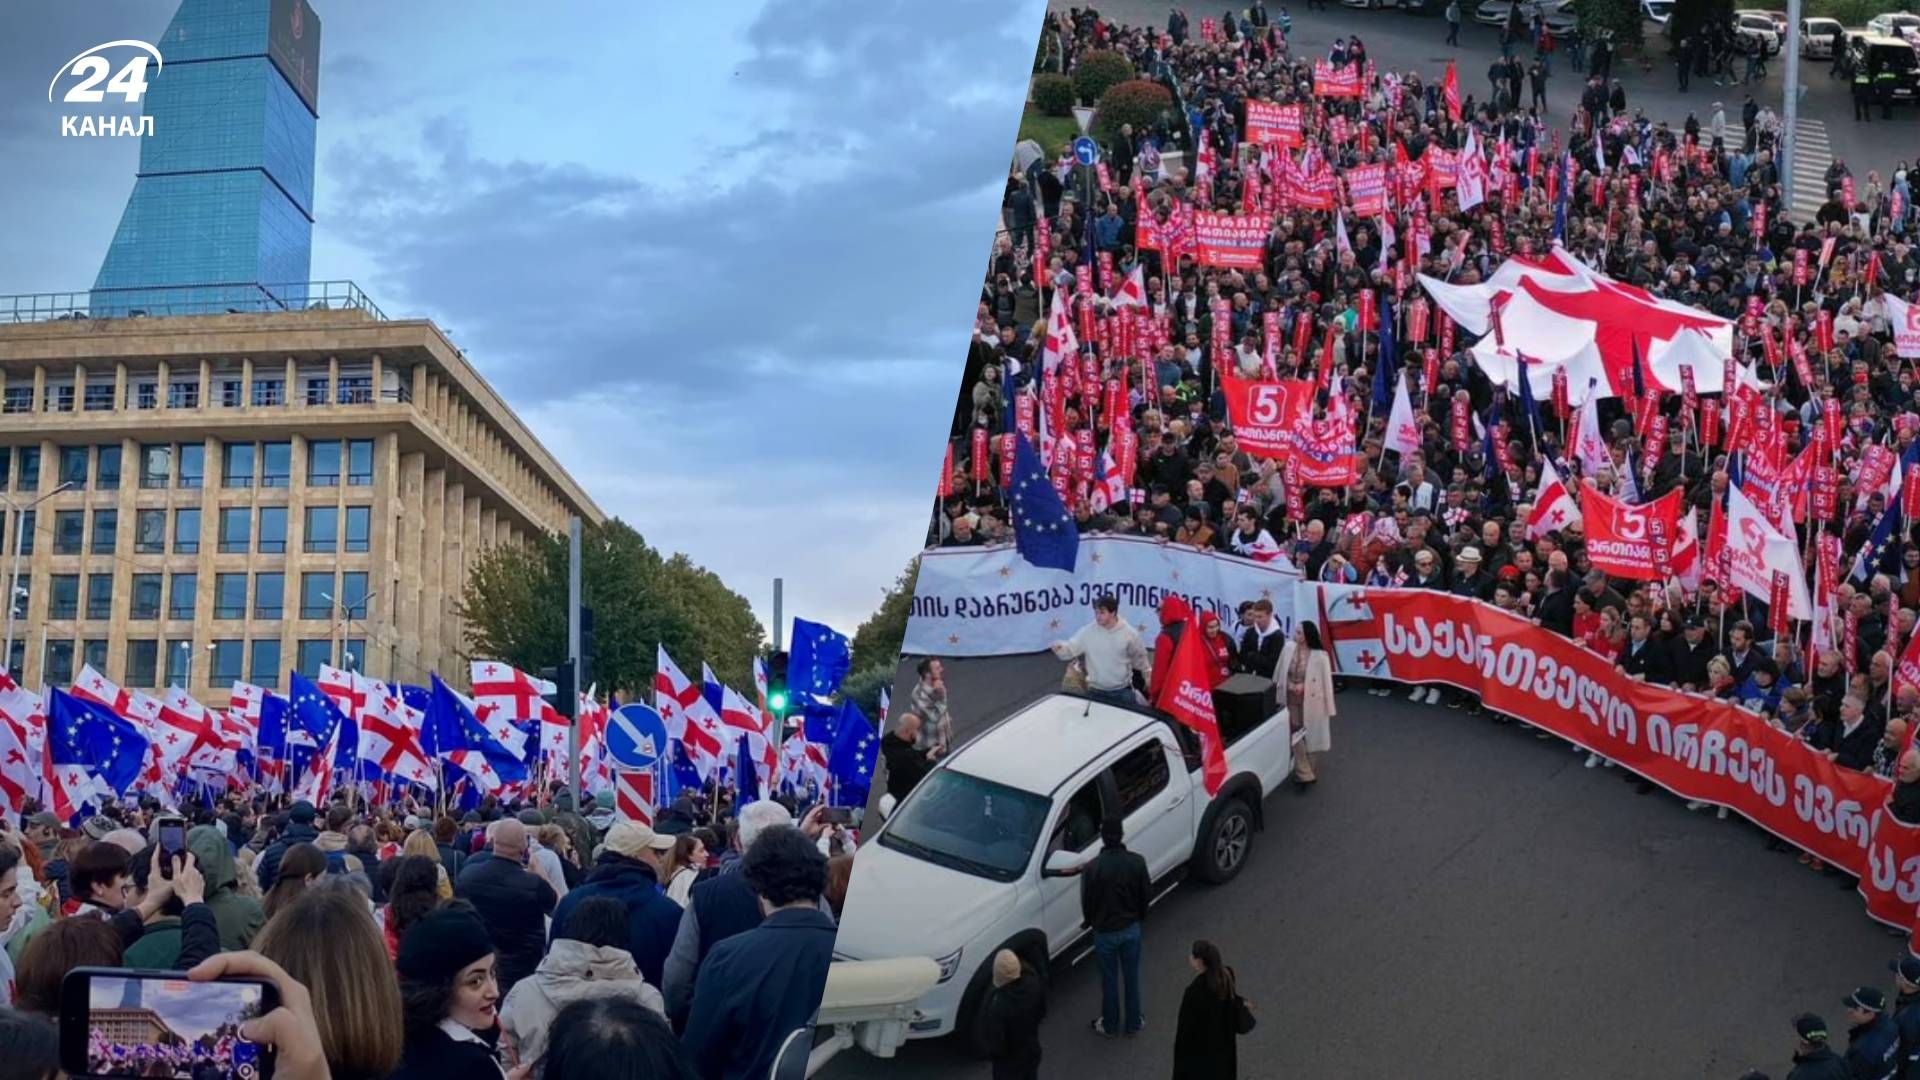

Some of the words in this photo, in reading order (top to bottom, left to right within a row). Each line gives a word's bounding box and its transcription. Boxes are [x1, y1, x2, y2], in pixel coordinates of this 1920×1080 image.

[1254, 387, 1279, 423] 5
[1621, 509, 1647, 540] 5
[1587, 538, 1651, 559] ერთიან
[955, 583, 1075, 619] დაბრუნება
[1383, 612, 1638, 745] საქართველო
[1646, 714, 1786, 807] ირჩევს
